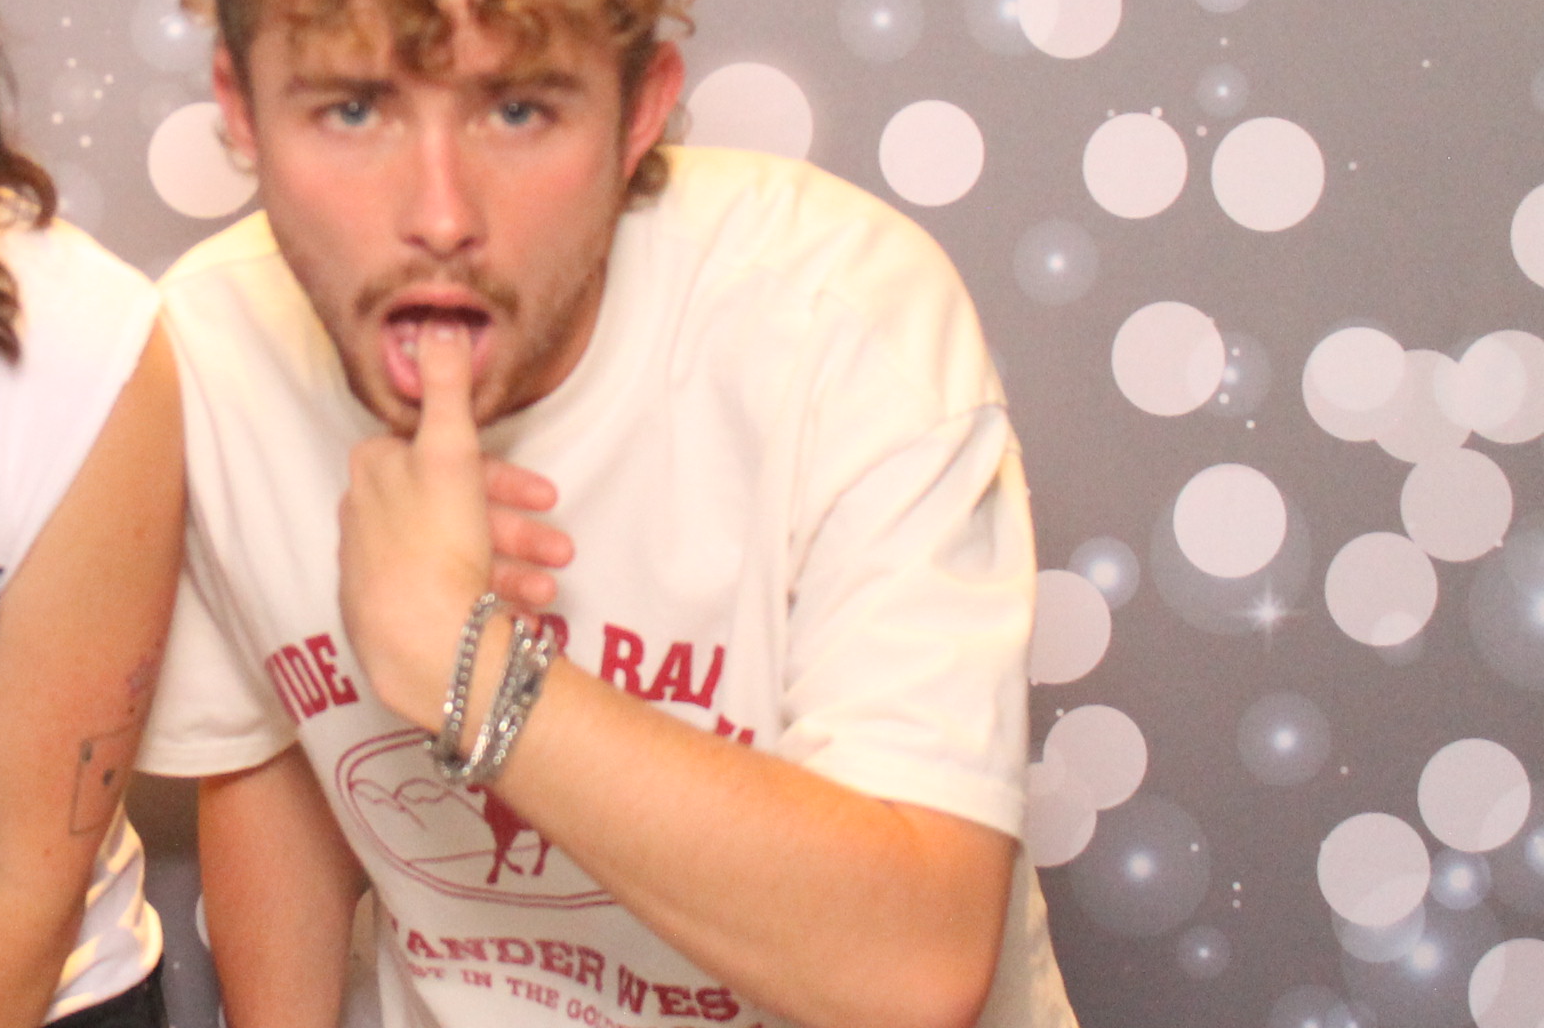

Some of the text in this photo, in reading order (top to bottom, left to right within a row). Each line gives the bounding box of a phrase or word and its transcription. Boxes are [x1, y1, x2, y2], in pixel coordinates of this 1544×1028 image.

[392, 917, 606, 993] ANDER
[460, 968, 493, 989] IN
[505, 976, 561, 1010] THE
